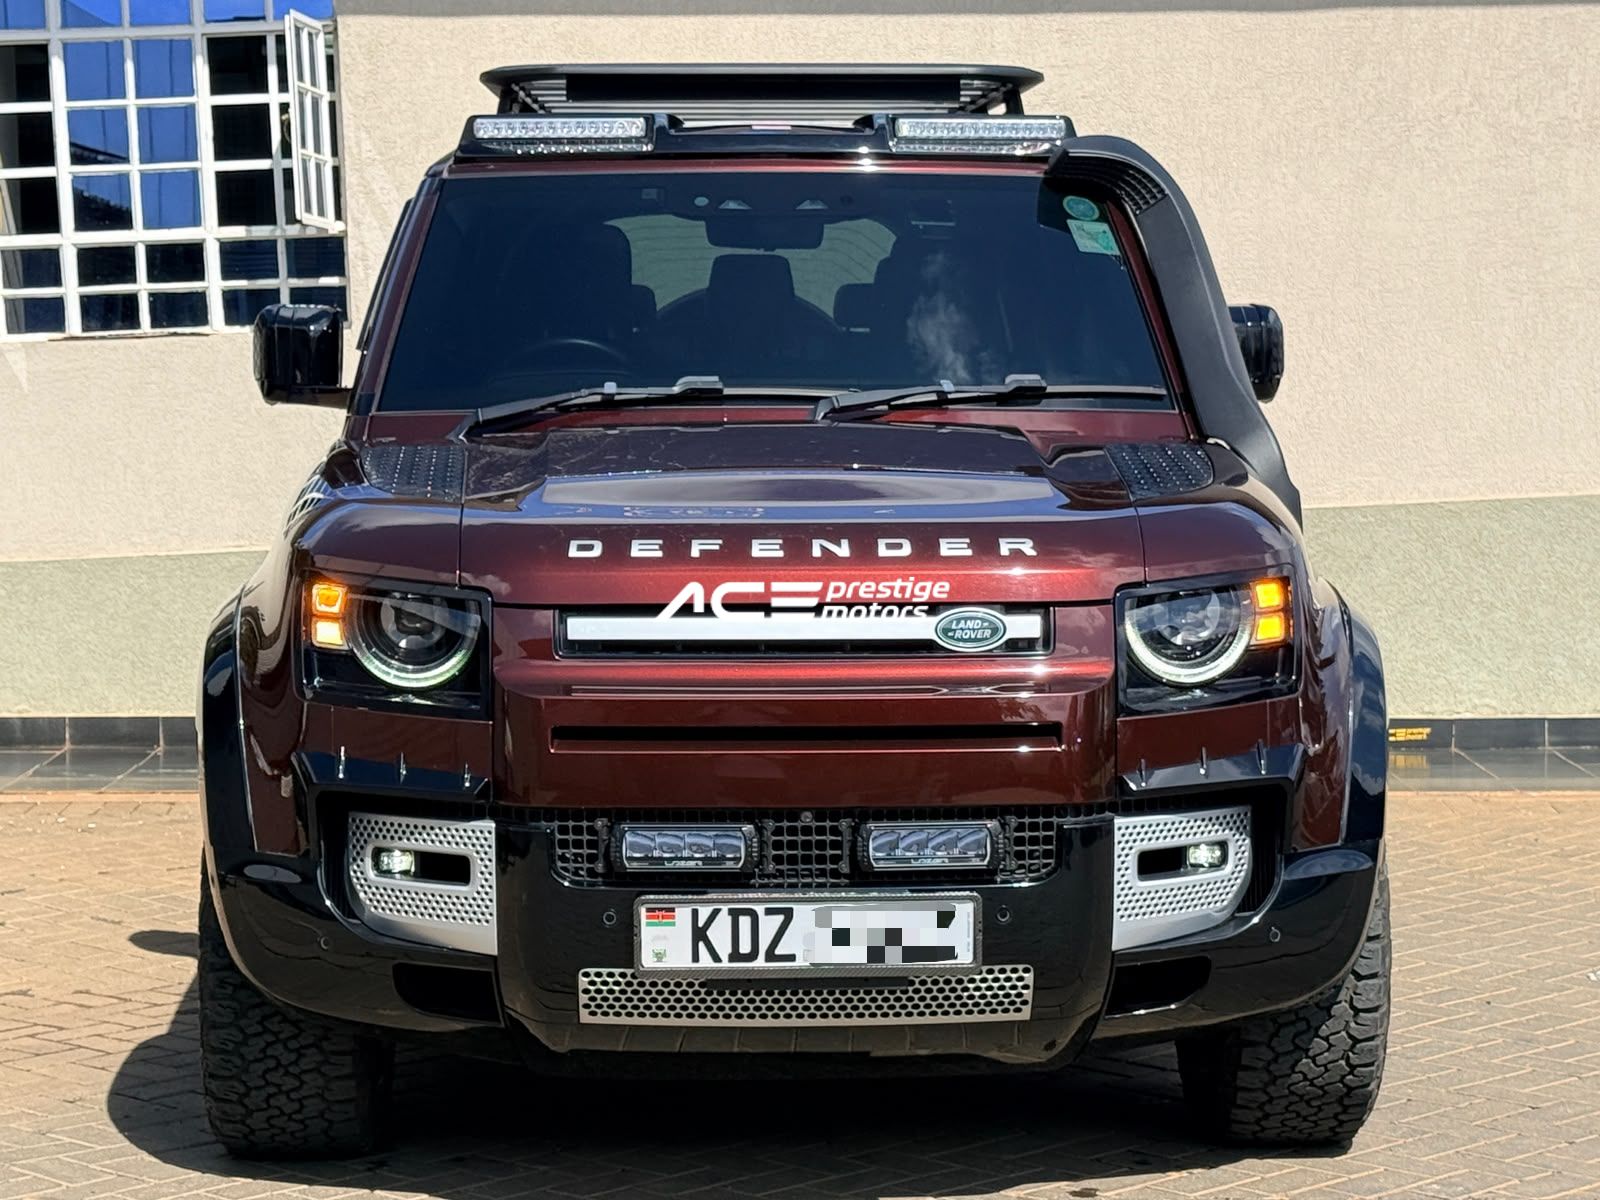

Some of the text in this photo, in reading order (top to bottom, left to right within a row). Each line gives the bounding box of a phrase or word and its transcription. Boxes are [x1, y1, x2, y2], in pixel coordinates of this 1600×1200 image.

[567, 536, 1038, 558] DEFENDER
[951, 619, 982, 630] LAND
[953, 629, 992, 639] ROVER
[691, 907, 797, 963] KDZ
